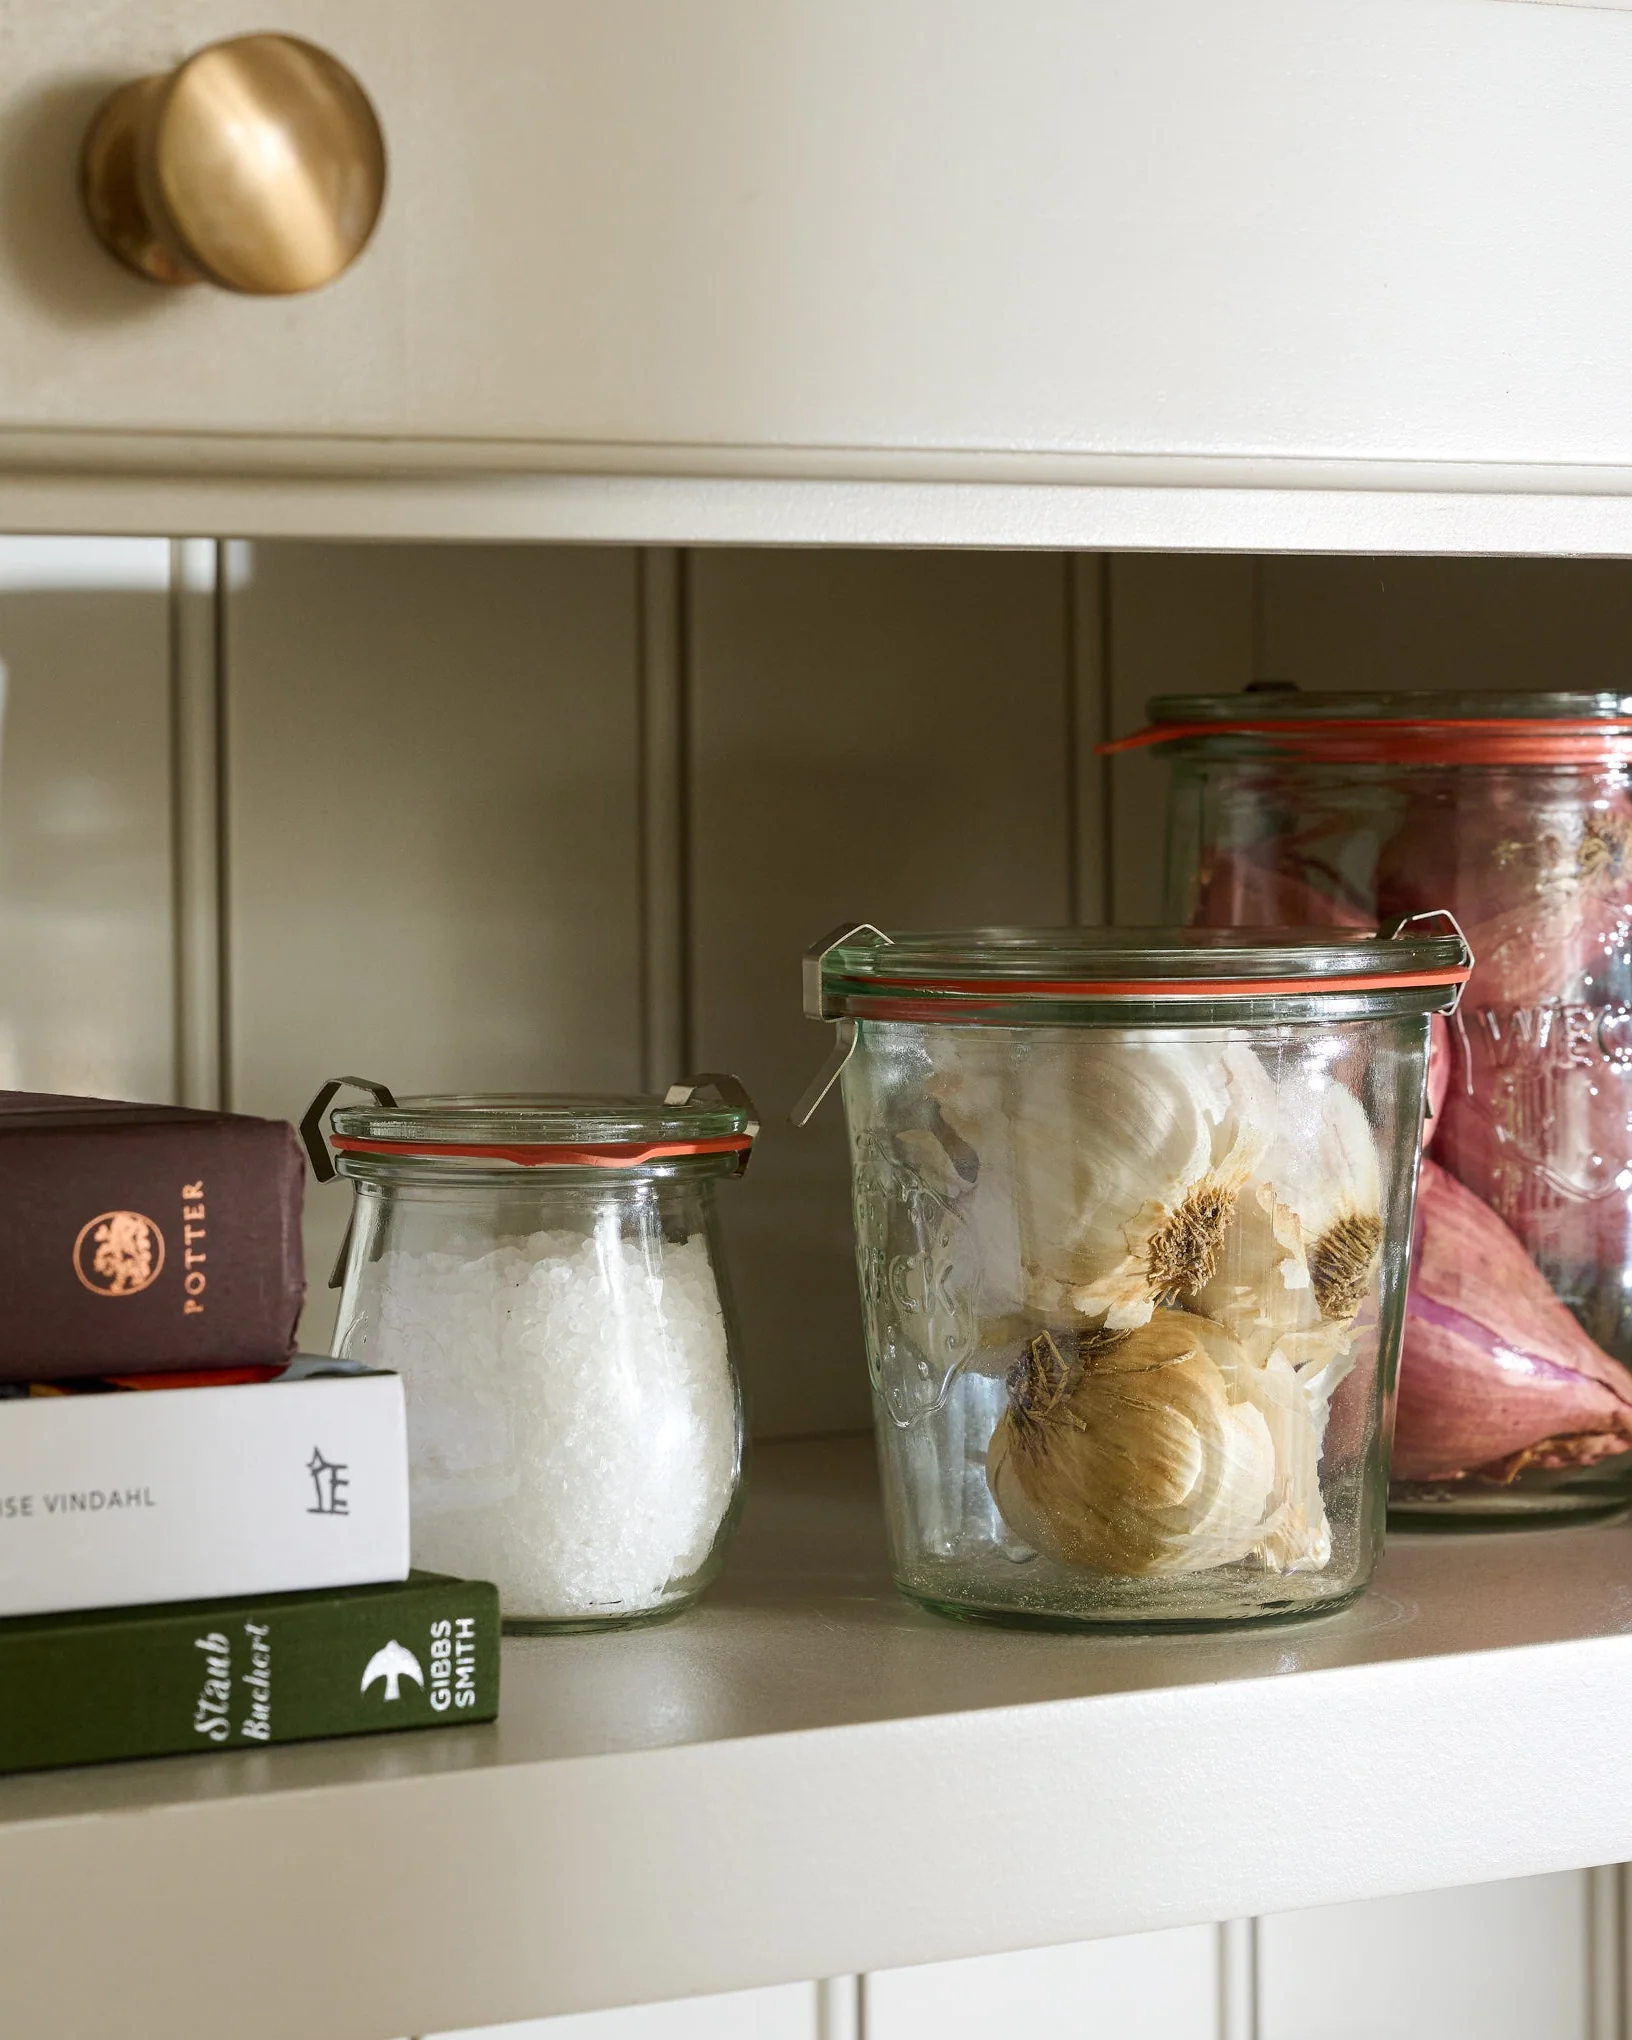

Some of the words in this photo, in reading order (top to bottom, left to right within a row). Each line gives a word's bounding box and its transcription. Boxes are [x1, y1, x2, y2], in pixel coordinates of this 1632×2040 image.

[181, 1180, 207, 1315] POTTER
[42, 1486, 157, 1514] VINDAHL
[194, 1632, 232, 1741] Staub
[430, 1619, 452, 1712] GIBBS
[455, 1618, 476, 1708] SMITH
